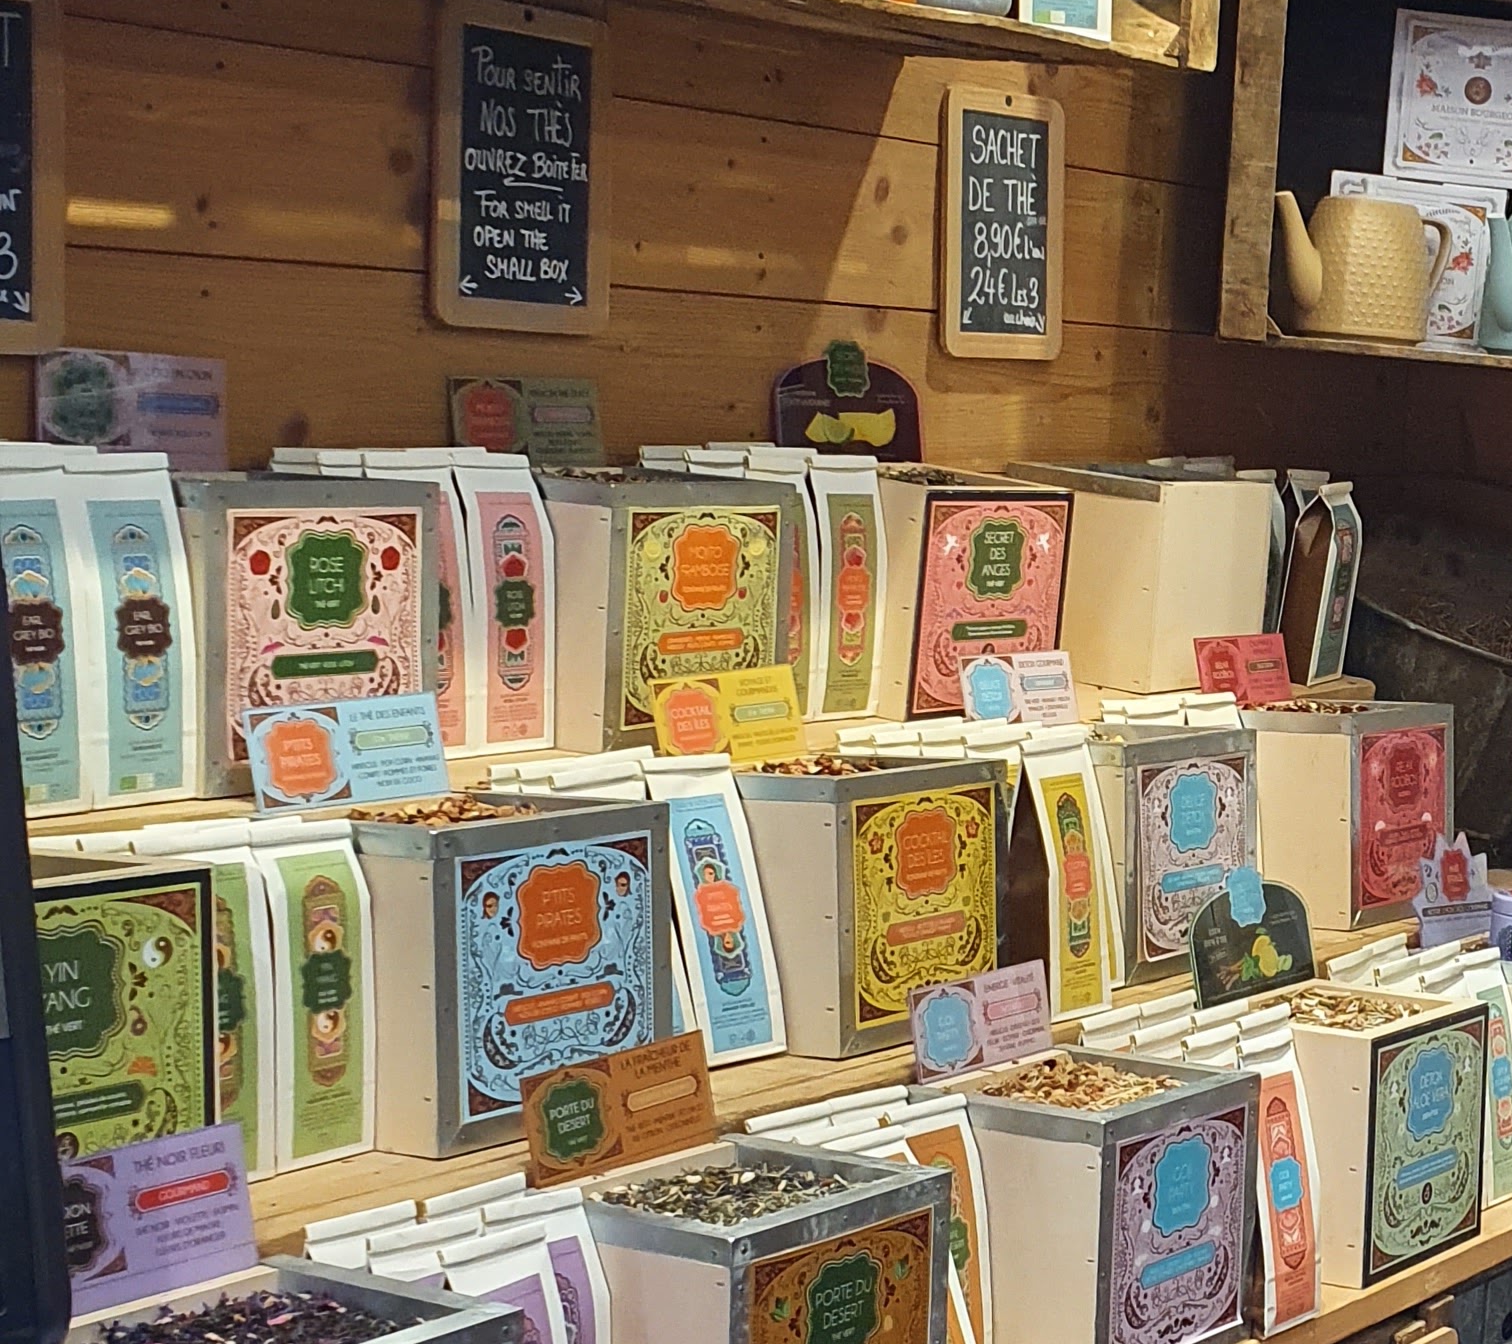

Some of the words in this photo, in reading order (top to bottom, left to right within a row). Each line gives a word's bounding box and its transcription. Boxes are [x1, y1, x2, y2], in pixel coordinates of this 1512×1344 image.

[471, 45, 517, 91] POUR
[480, 99, 517, 138] NOS
[464, 147, 526, 178] OUVREZ
[970, 125, 1041, 169] SACHET
[474, 190, 510, 220] FOR
[514, 200, 553, 223] SMELL
[968, 175, 995, 213] DE
[473, 225, 515, 250] OPEN
[519, 227, 549, 251] THE
[974, 221, 1024, 269] 8,90€
[484, 253, 537, 283] SMALL
[540, 256, 570, 284] BOX
[968, 266, 1009, 306] 24€
[1029, 277, 1040, 309] 3
[310, 557, 344, 573] ROSE
[989, 547, 1006, 560] DES
[44, 960, 78, 983] YIN
[43, 986, 90, 1014] ANG
[549, 1102, 579, 1121] PORTE
[580, 1097, 594, 1111] DU
[815, 1282, 853, 1309] PORTE
[855, 1277, 873, 1294] DU
[823, 1300, 865, 1329] DESERT
